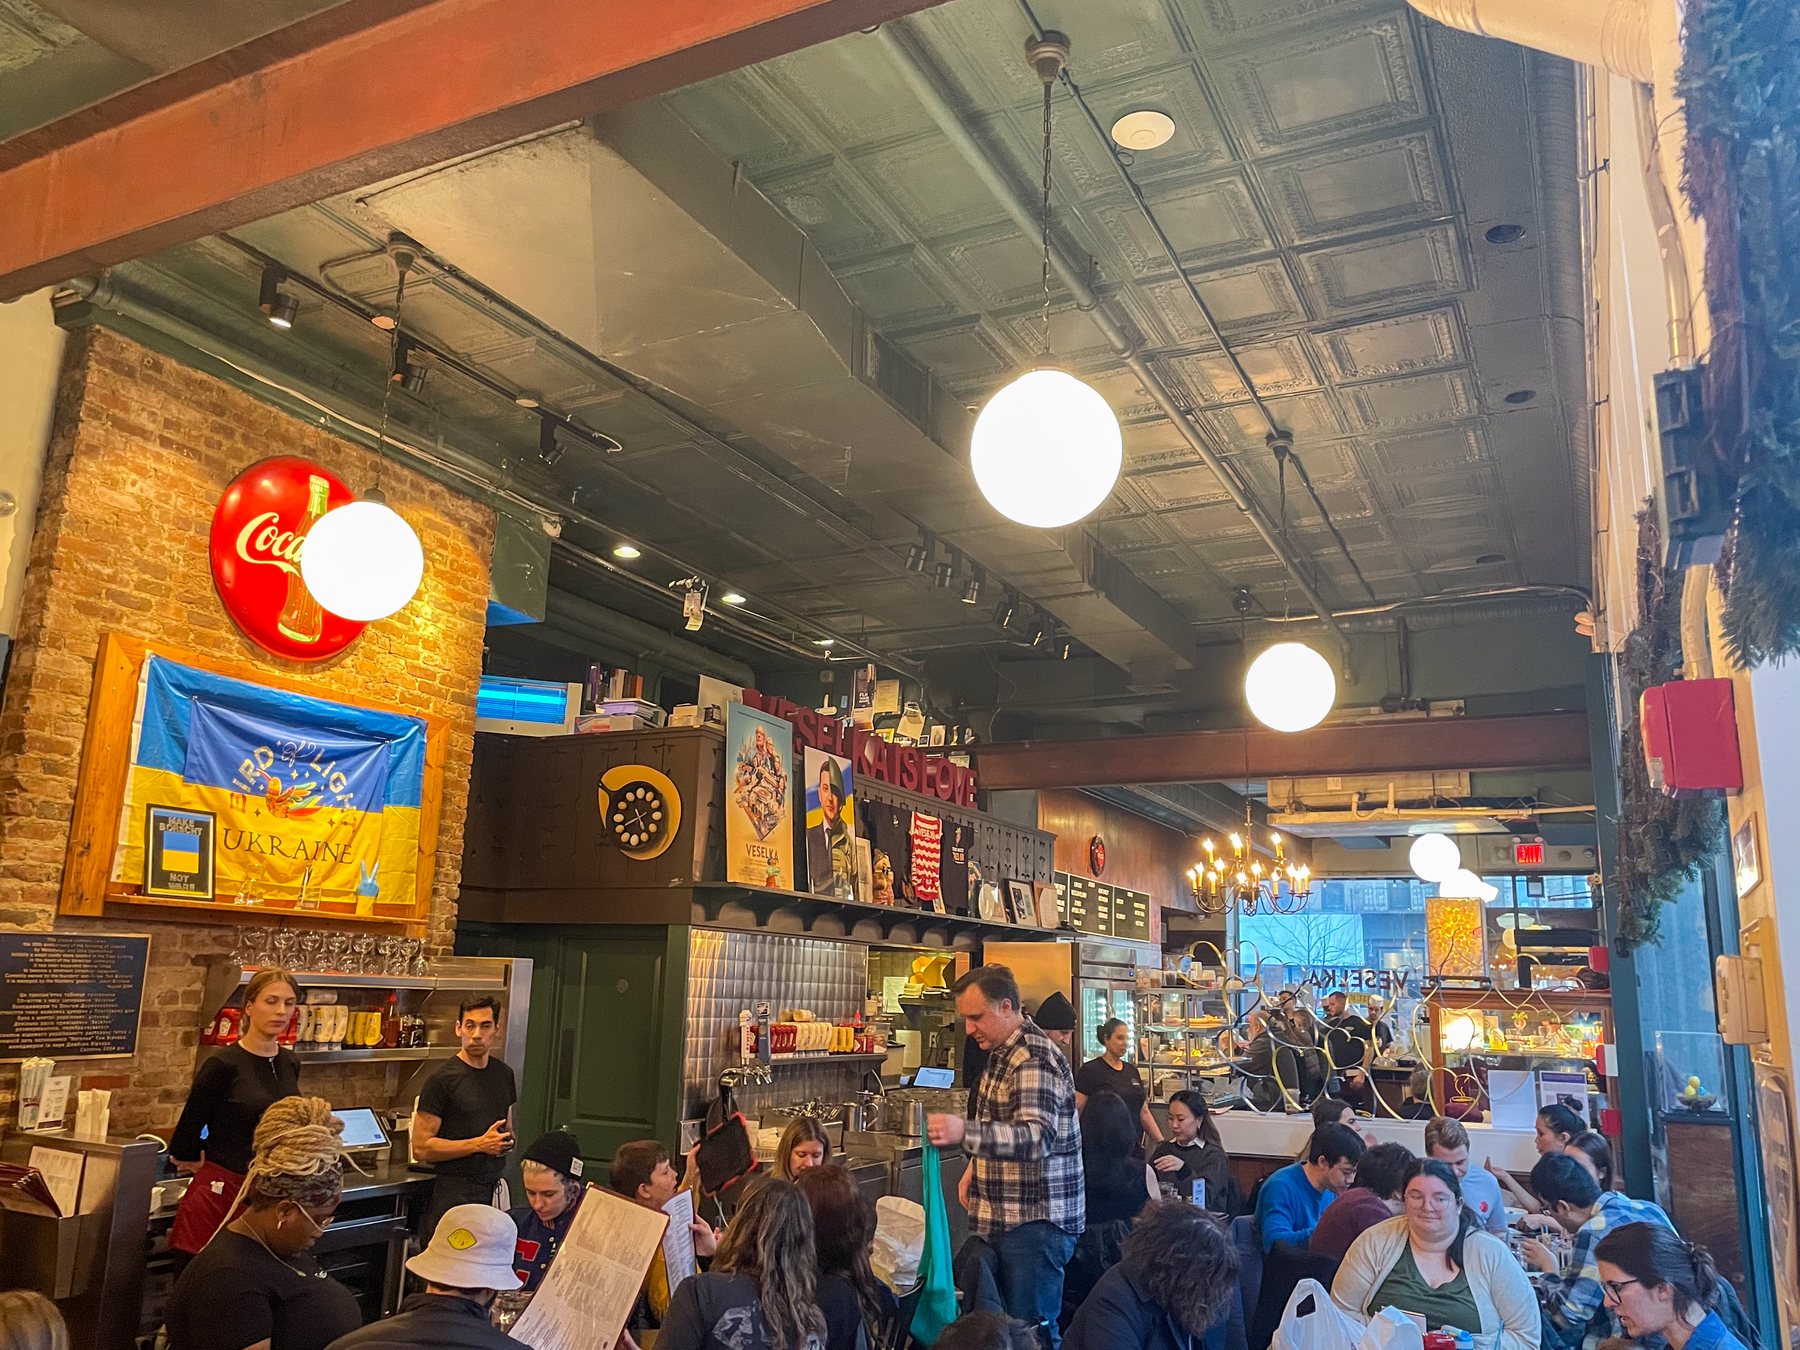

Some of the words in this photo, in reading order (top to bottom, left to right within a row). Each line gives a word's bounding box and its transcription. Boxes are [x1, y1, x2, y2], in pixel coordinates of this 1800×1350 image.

[236, 512, 306, 577] Coca
[281, 740, 317, 768] of
[894, 742, 919, 792] IS
[921, 750, 978, 811] LOVE
[159, 822, 203, 836] BORSCHT
[168, 816, 195, 828] MAKE
[223, 828, 354, 865] UKRAINE
[745, 843, 779, 864] VESELKA
[169, 872, 190, 883] NOT
